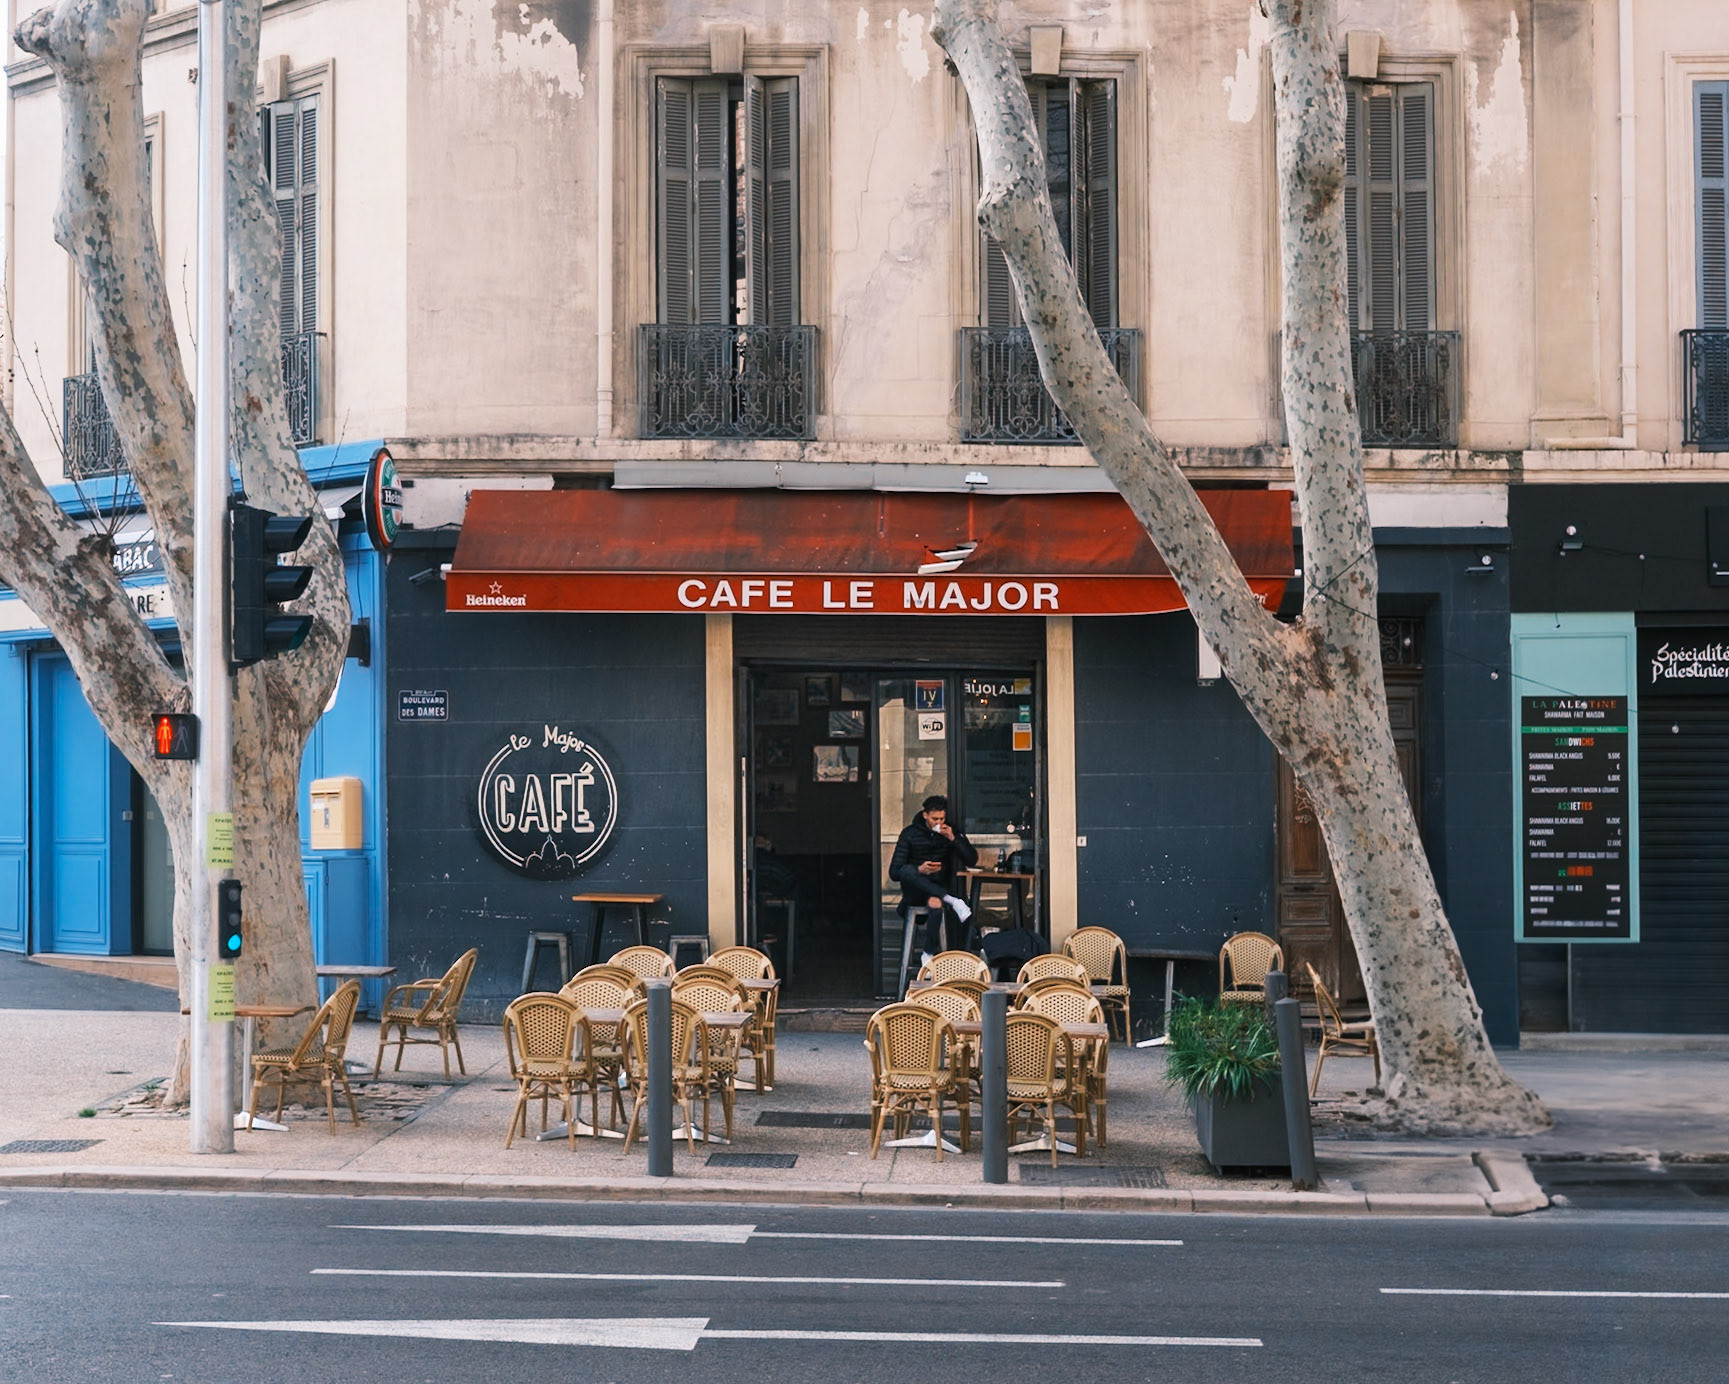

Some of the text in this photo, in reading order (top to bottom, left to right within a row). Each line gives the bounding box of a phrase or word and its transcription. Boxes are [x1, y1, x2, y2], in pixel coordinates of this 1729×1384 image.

[113, 545, 154, 572] ABAC
[466, 593, 526, 606] Heineken
[677, 579, 1060, 610] CAFE LE MAJOR
[403, 696, 445, 704] BOULEVARD
[1552, 700, 1617, 709] PALETINE
[402, 707, 446, 717] DES DAMES
[1544, 711, 1605, 719] SHAWARMA FAIT MAISON
[542, 724, 585, 753] Major
[494, 761, 595, 833] CAFÉ
[1558, 802, 1593, 811] ASSIETTES
